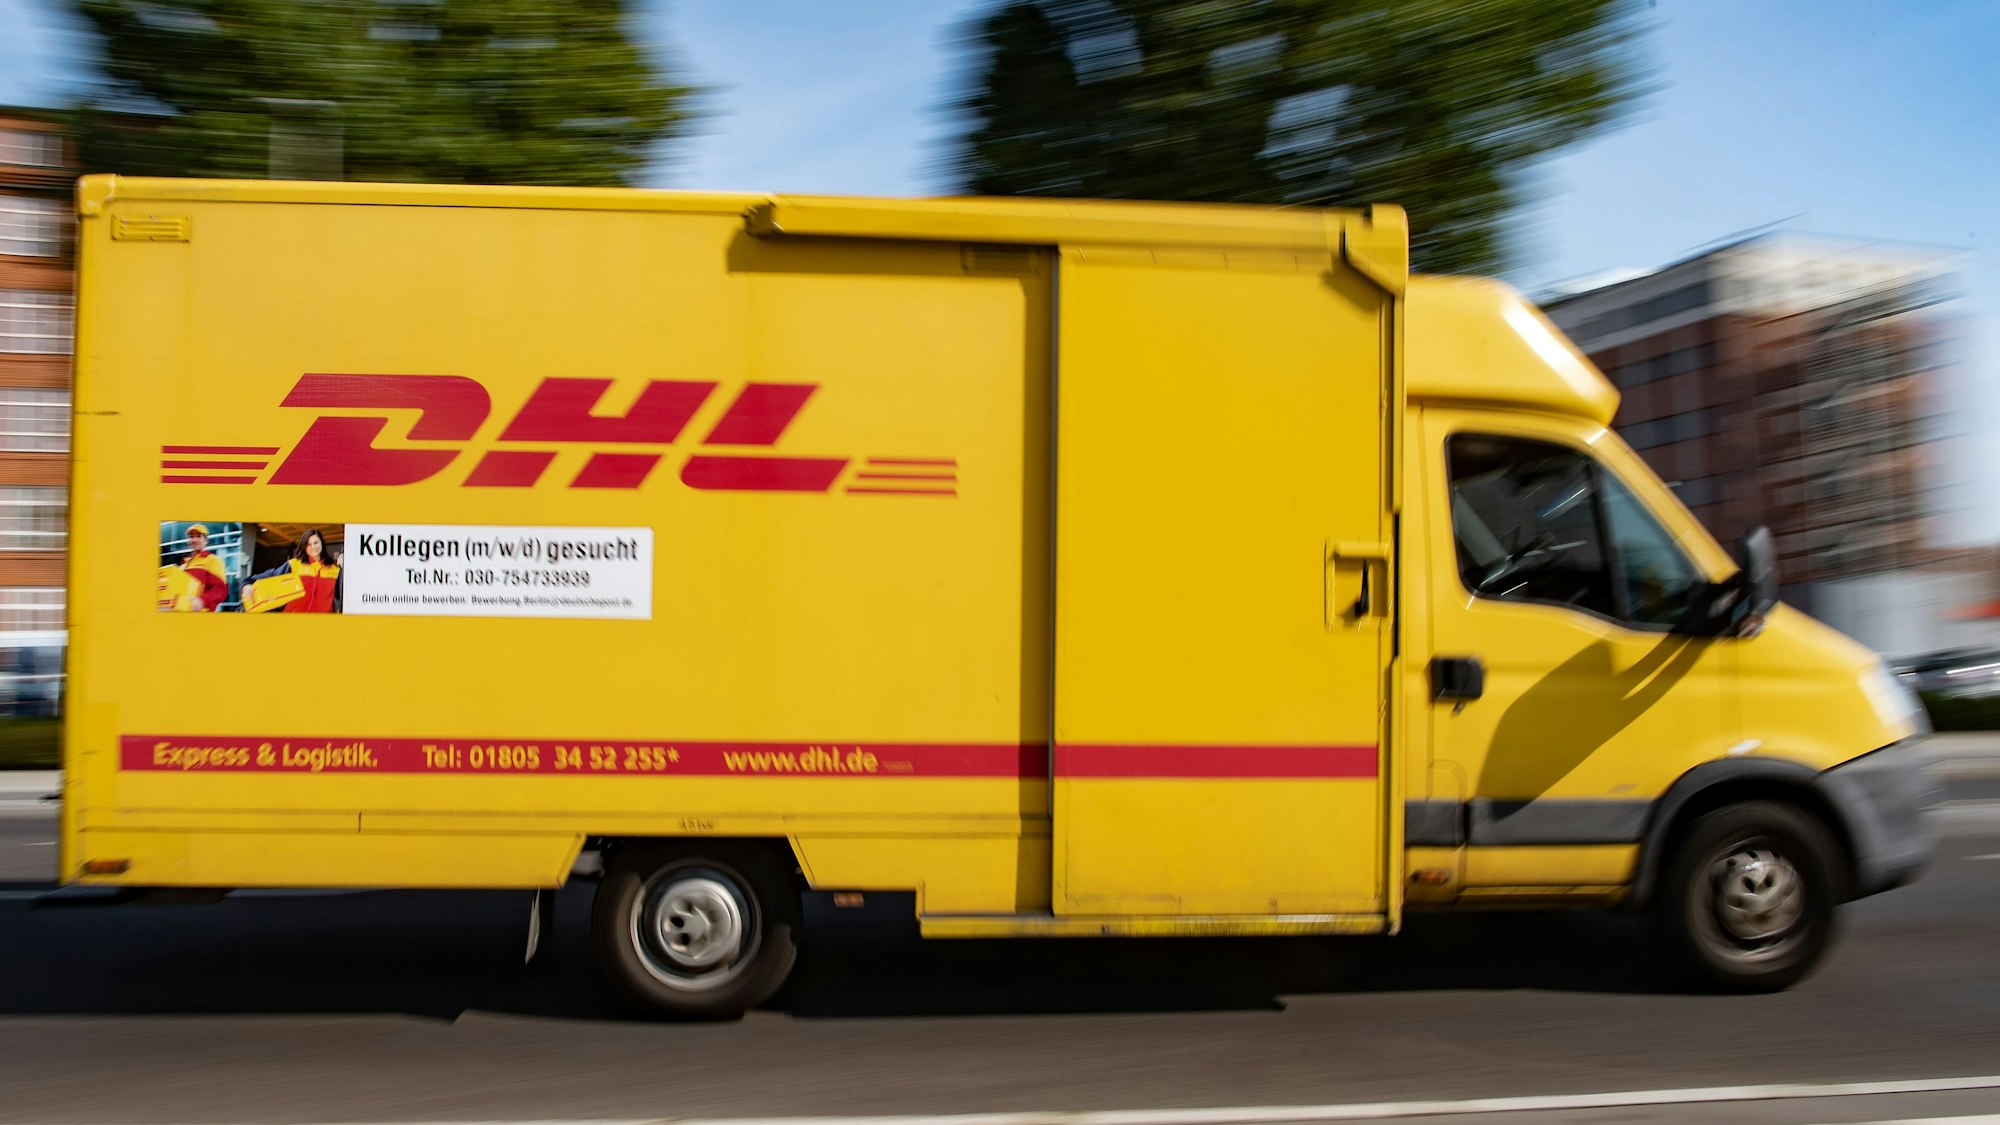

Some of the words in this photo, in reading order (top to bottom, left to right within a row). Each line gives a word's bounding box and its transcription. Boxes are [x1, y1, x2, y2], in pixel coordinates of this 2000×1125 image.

[267, 373, 851, 493] DHL
[360, 534, 459, 562] Kollegen
[465, 536, 541, 563] (m/w/d)
[546, 537, 638, 564] gesucht
[406, 568, 459, 585] Tel.Nr.:
[465, 569, 591, 587] 030-754733939
[362, 593, 389, 604] Gleich
[392, 593, 419, 604] online
[153, 742, 250, 770] Express
[256, 743, 276, 767] &
[282, 742, 378, 772] Logistik.
[422, 745, 462, 769] Tel:
[469, 745, 541, 769] 01805
[554, 746, 584, 770] 34
[590, 746, 617, 770] 52
[723, 746, 878, 773] www.dhl.de
